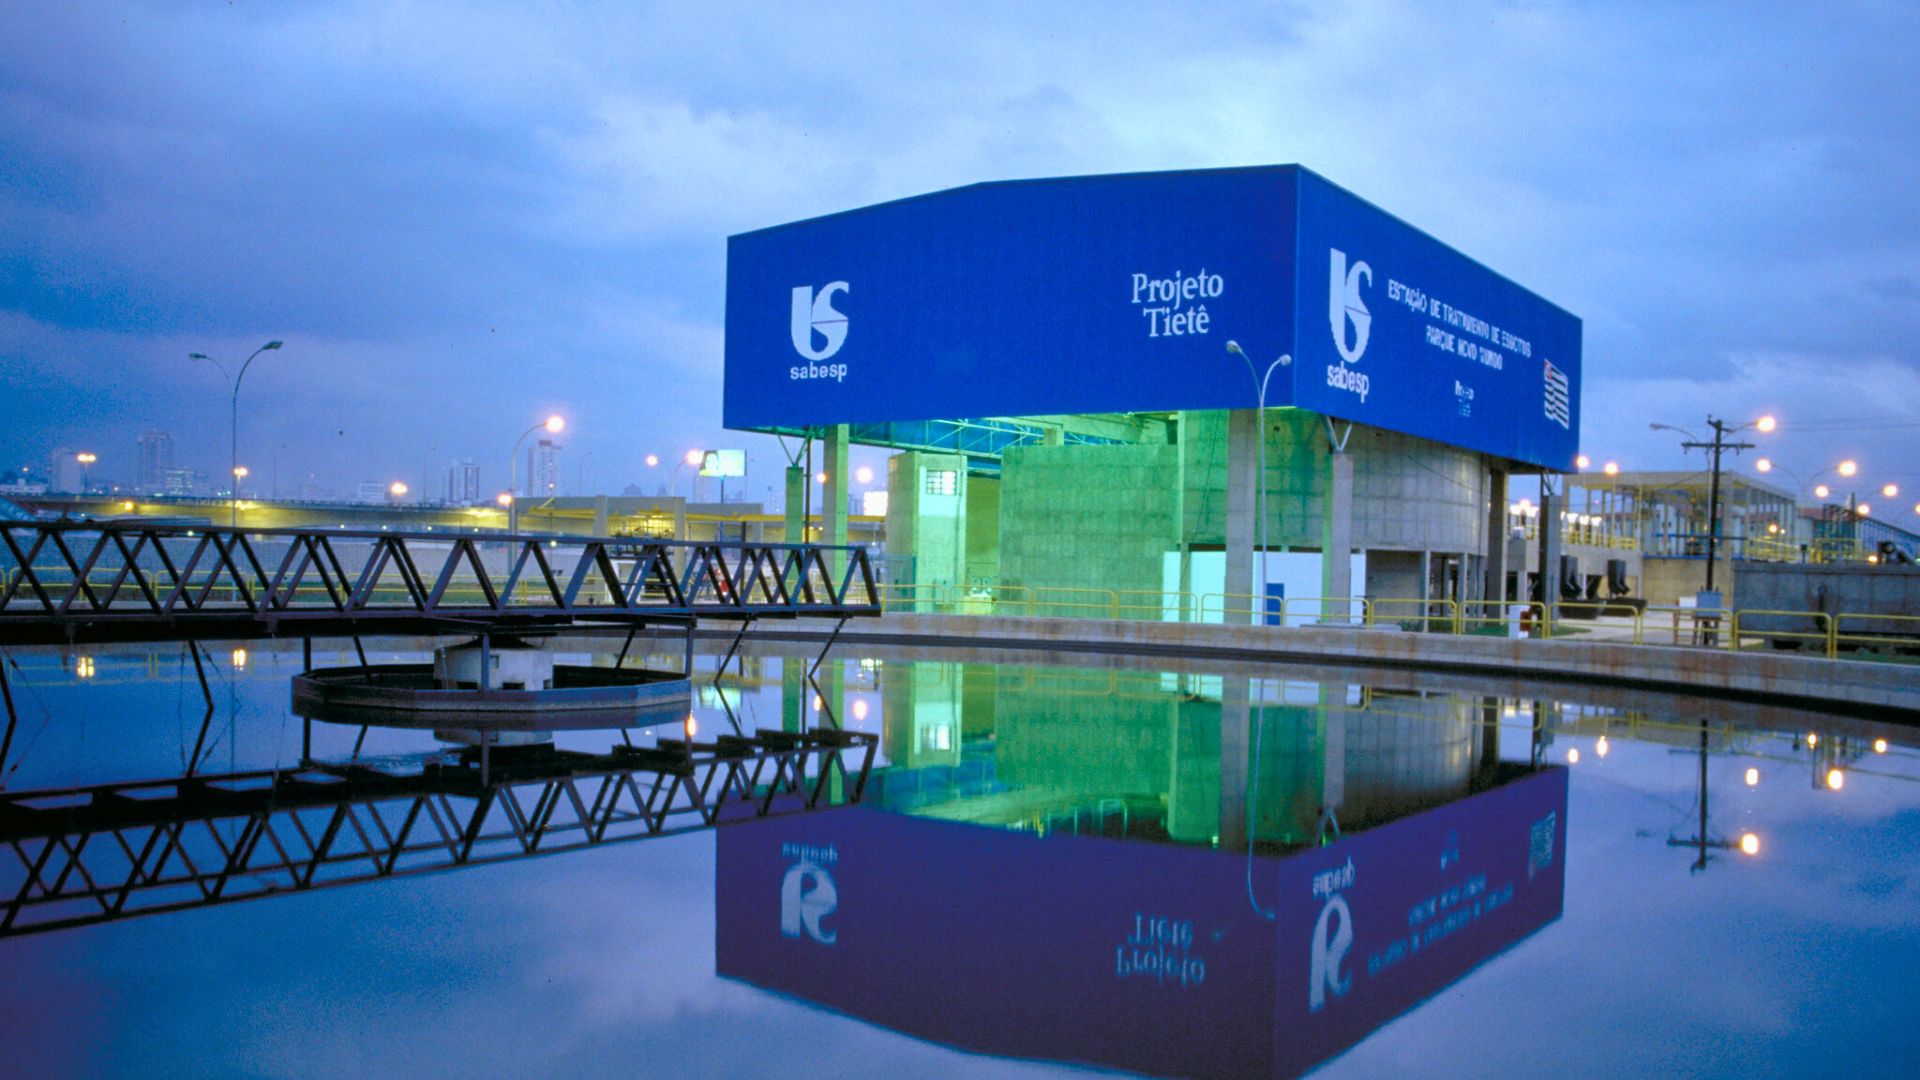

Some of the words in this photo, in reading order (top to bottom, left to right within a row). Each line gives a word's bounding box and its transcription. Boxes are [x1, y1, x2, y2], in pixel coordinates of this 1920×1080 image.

[1131, 267, 1223, 310] Projeto
[1143, 304, 1209, 337] Tietê
[1430, 298, 1441, 318] DE
[790, 361, 847, 382] sabesp
[1327, 360, 1369, 403] sabesp
